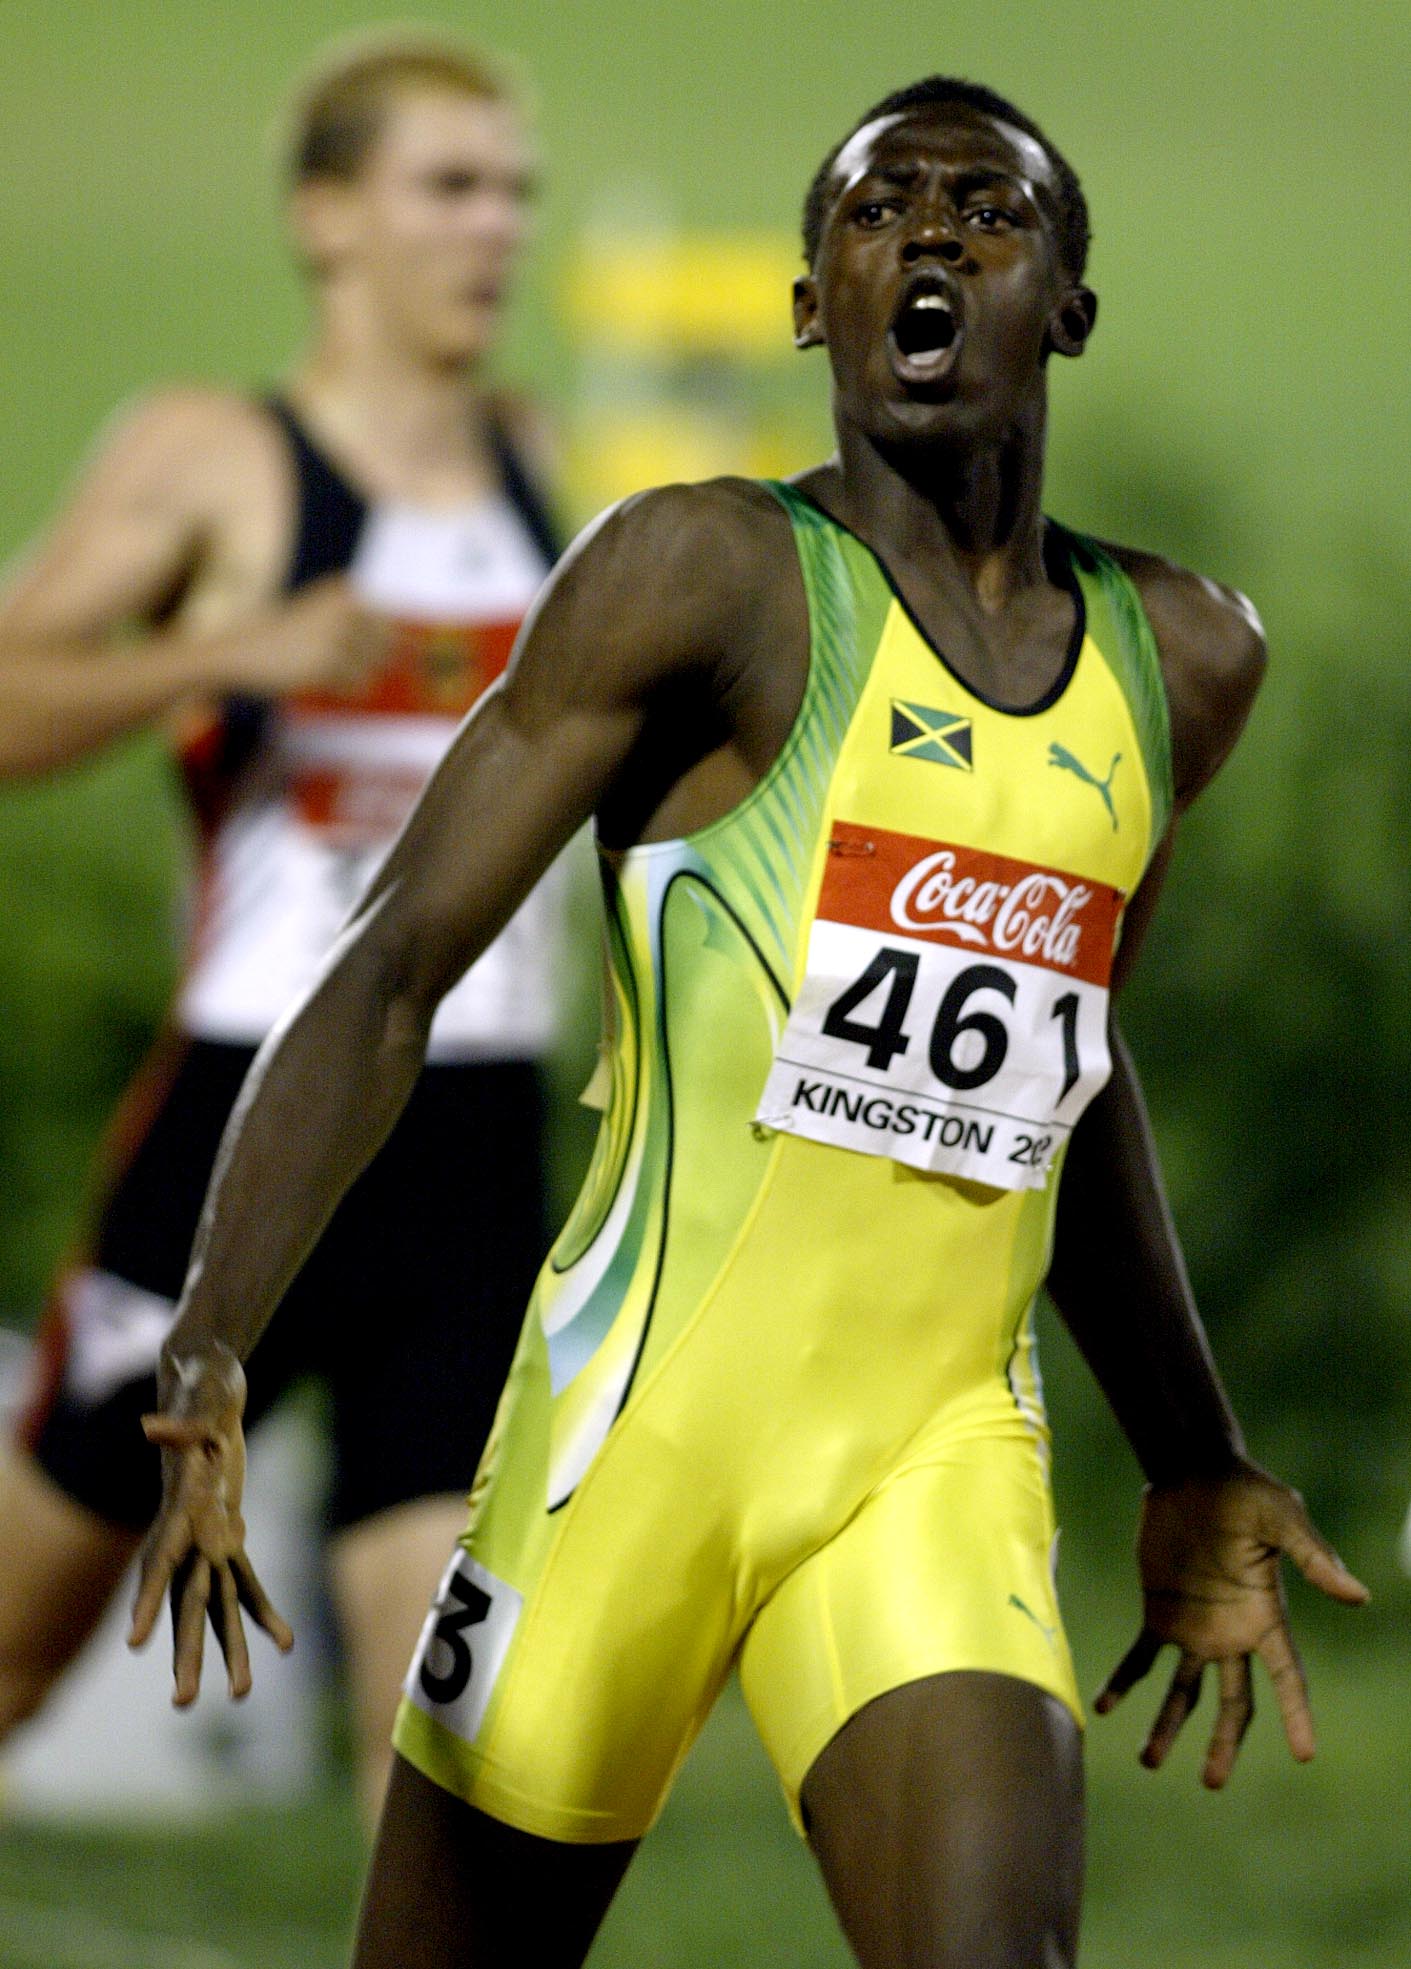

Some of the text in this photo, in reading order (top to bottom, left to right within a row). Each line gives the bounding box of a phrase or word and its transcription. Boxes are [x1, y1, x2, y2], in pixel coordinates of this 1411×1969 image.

[890, 850, 1092, 966] Coca-Cola
[821, 946, 1080, 1110] 461
[791, 1079, 994, 1154] KINGSTON
[420, 1571, 492, 1704] 3
